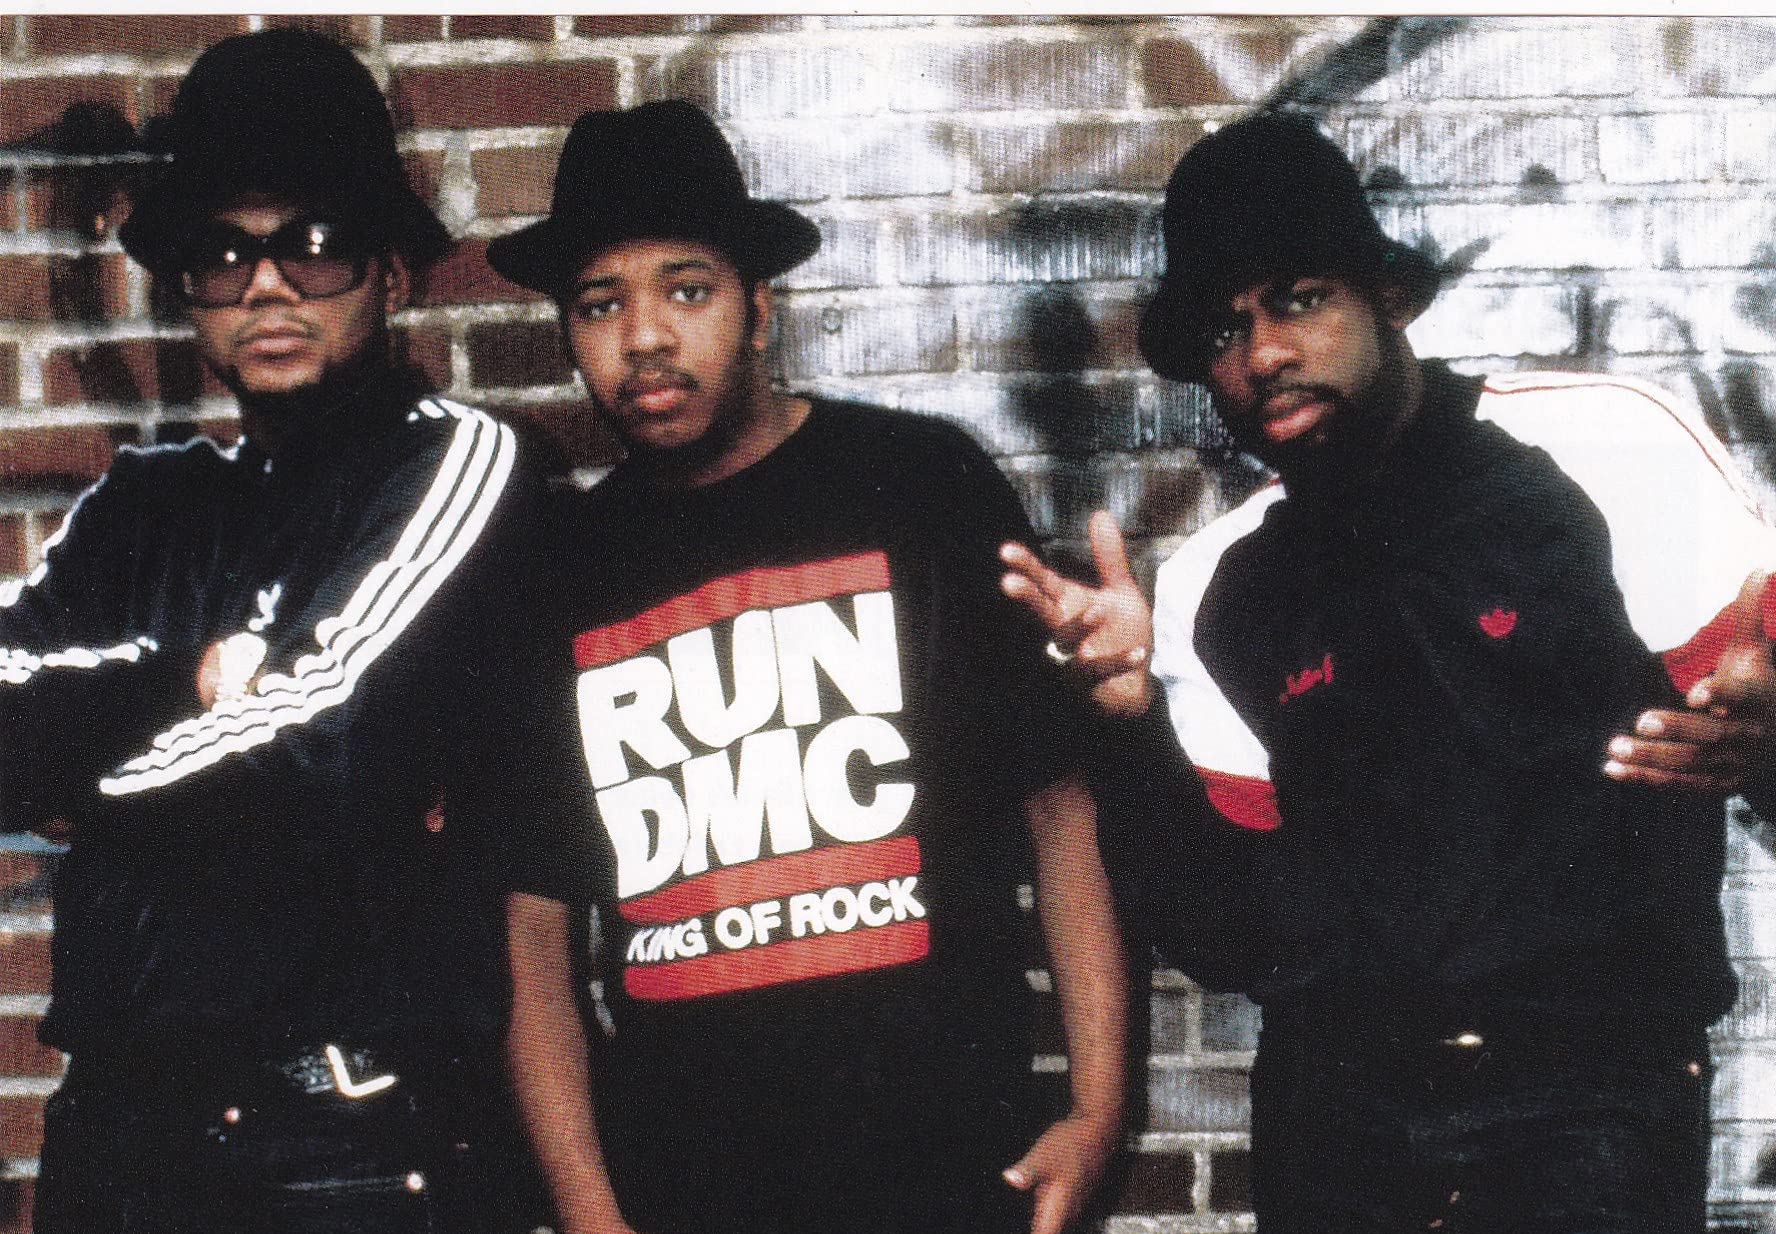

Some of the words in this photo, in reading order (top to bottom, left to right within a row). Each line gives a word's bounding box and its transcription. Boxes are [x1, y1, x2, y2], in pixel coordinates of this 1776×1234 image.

[577, 592, 903, 787] RUN
[596, 716, 915, 899] DMC
[715, 901, 781, 949] OF
[789, 876, 926, 937] ROCK
